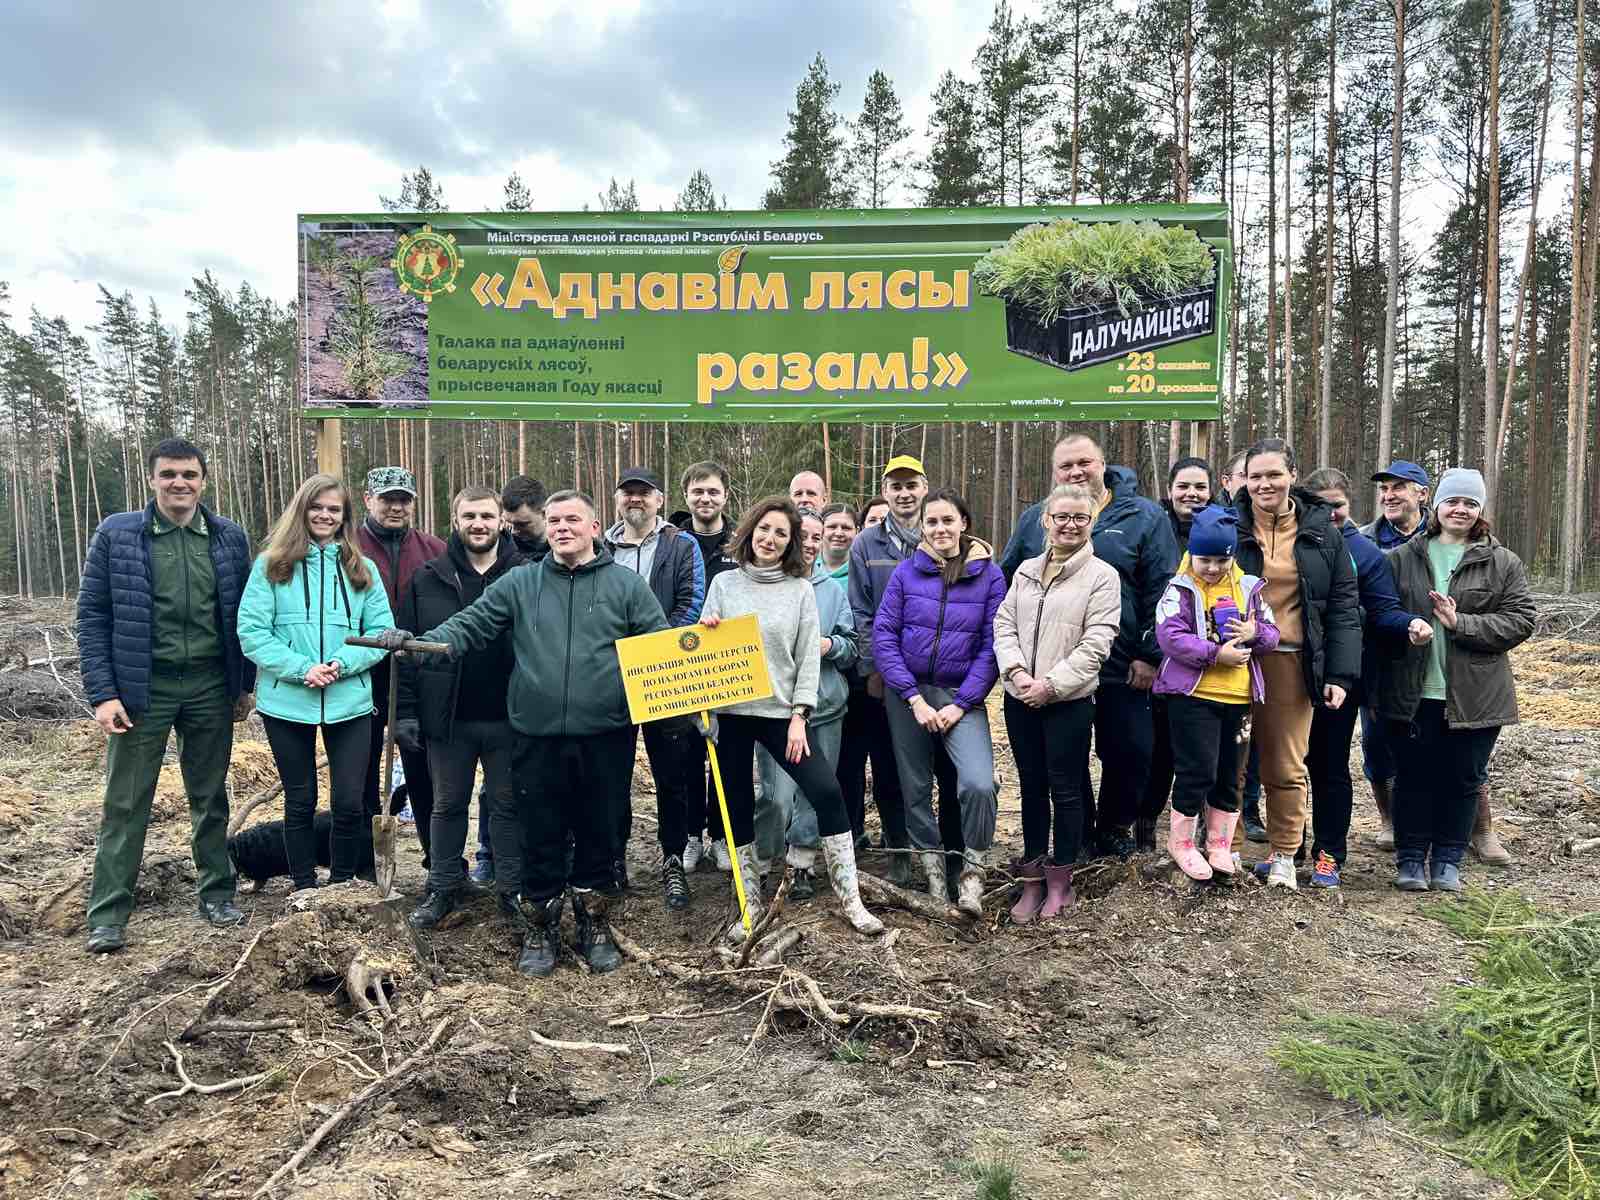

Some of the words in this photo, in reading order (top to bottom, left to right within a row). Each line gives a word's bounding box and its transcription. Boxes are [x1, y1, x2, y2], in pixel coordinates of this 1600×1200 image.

[487, 231, 569, 244] Міністэрства
[571, 230, 617, 243] лясной
[619, 231, 689, 244] гаспадаркі
[692, 230, 760, 244] Рэспублікі
[763, 230, 824, 243] Беларусь
[470, 254, 789, 319] «Аднавім
[803, 270, 969, 310] лясы
[435, 334, 496, 349] Талака
[500, 339, 522, 349] па
[527, 335, 625, 352] аднаўленні
[1069, 300, 1210, 362] ДАЛУЧАЙЦЕСЯ!
[437, 355, 533, 373] беларускіх
[537, 356, 592, 374] лясоў,
[697, 337, 968, 404] разам!»
[1126, 351, 1155, 371] 23
[437, 379, 558, 394] прысвечаная
[562, 379, 600, 396] Году
[605, 379, 662, 395] якасці
[1126, 374, 1156, 393] 20
[1010, 397, 1064, 407] www.mlh.by
[627, 659, 685, 678] ИНСПЕКЦИЯ
[686, 644, 759, 666] МИНИСТЕРСТВА
[642, 678, 657, 688] ПО
[657, 669, 703, 686] НАЛОГАМ
[704, 667, 712, 676] И
[712, 660, 749, 675] СБОРАМ
[644, 683, 705, 702] РЕСПУБЛИКИ
[706, 674, 753, 689] БЕЛАРУСЬ
[648, 704, 662, 714] ПО
[663, 694, 711, 712] МИНСКОЙ
[711, 686, 754, 703] ОБЛАСТИ
